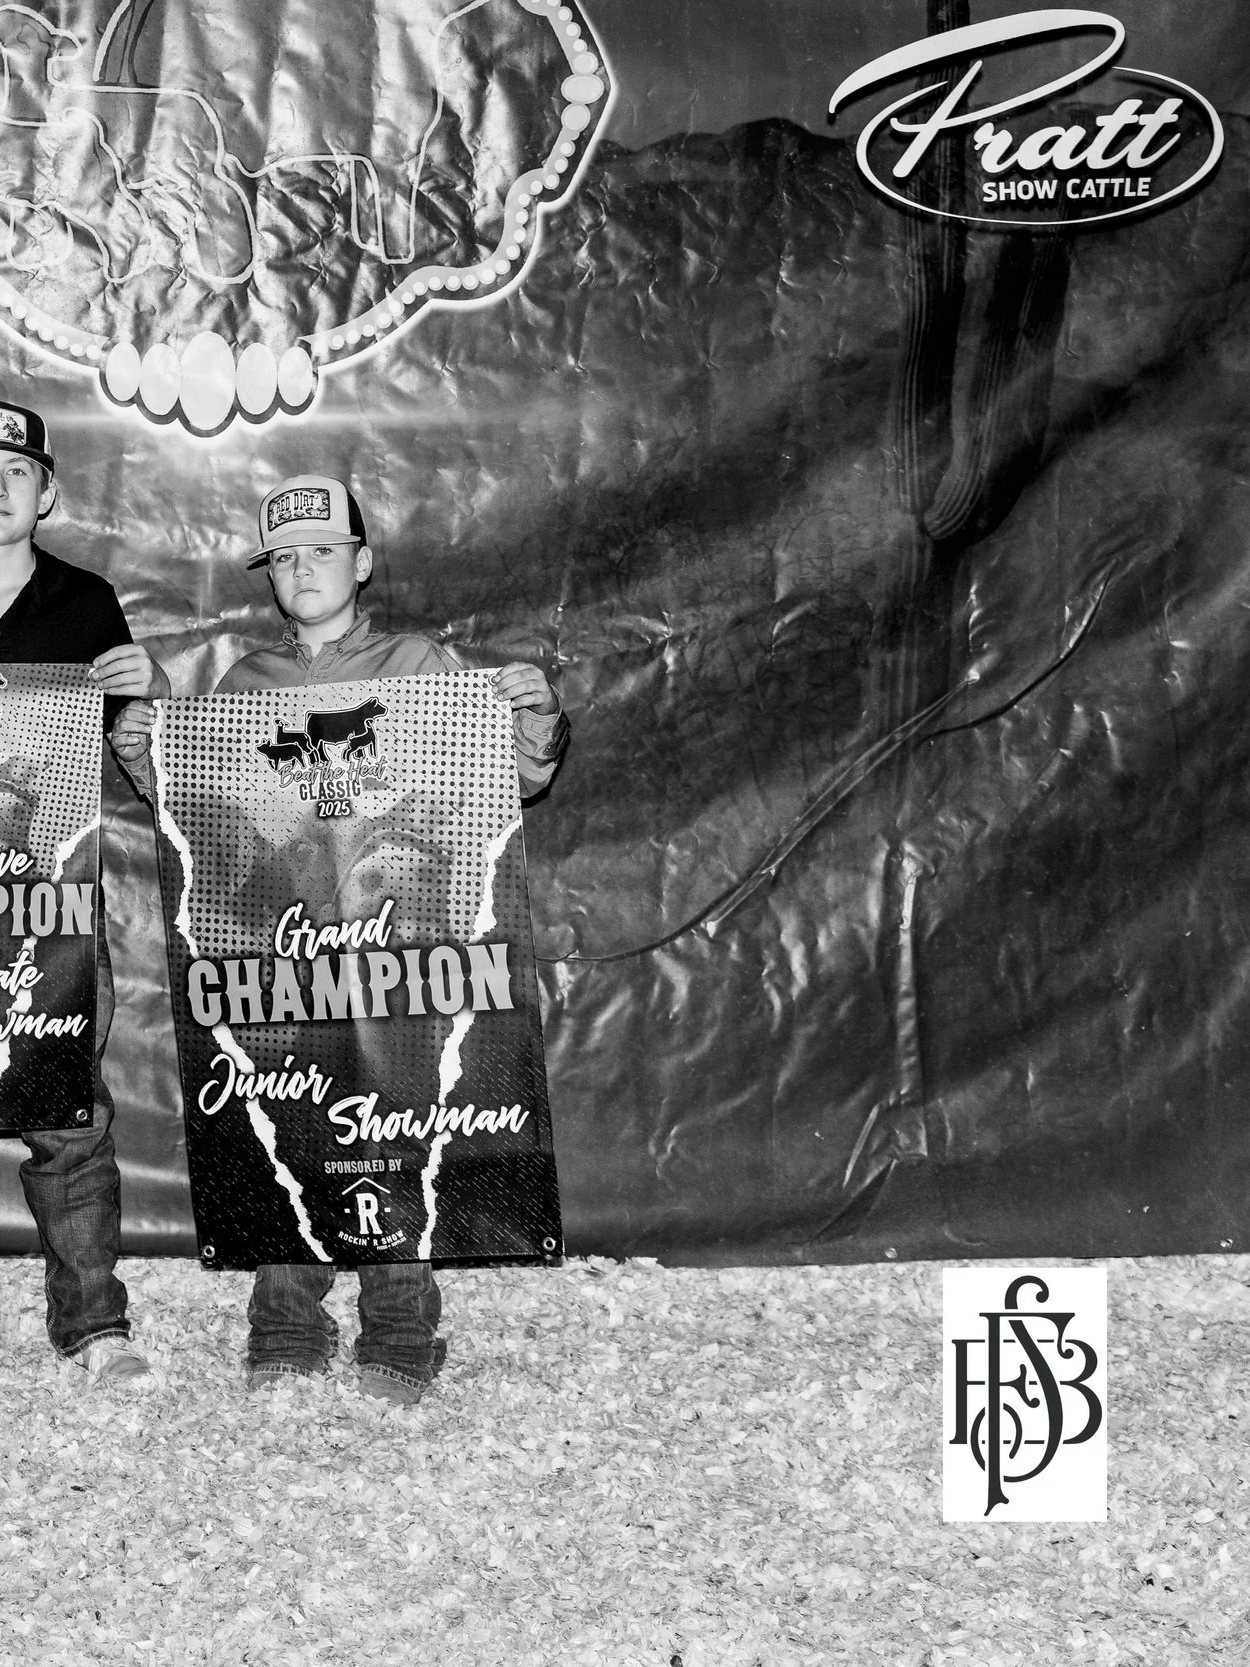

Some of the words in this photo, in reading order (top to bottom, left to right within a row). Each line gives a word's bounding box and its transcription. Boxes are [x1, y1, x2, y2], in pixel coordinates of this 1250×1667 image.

[828, 9, 1184, 179] Pratt
[982, 179, 1058, 202] SHOW
[1066, 177, 1151, 199] CATTLE
[293, 491, 315, 511] DIRT
[278, 761, 318, 789] Beat
[318, 760, 345, 785] the
[347, 755, 387, 785] Heat
[299, 780, 361, 801] CLASSIC
[318, 800, 351, 817] 2025
[274, 899, 395, 961] Grand
[187, 943, 515, 1027] CHAMPION
[198, 1053, 333, 1116] Junior
[327, 1092, 530, 1146] Showman
[324, 1159, 385, 1174] SPONSORED
[388, 1158, 402, 1172] BY
[355, 1192, 383, 1235] R
[338, 1230, 370, 1246] ROCKIN'
[372, 1238, 379, 1246] R
[381, 1229, 405, 1245] SHOW
